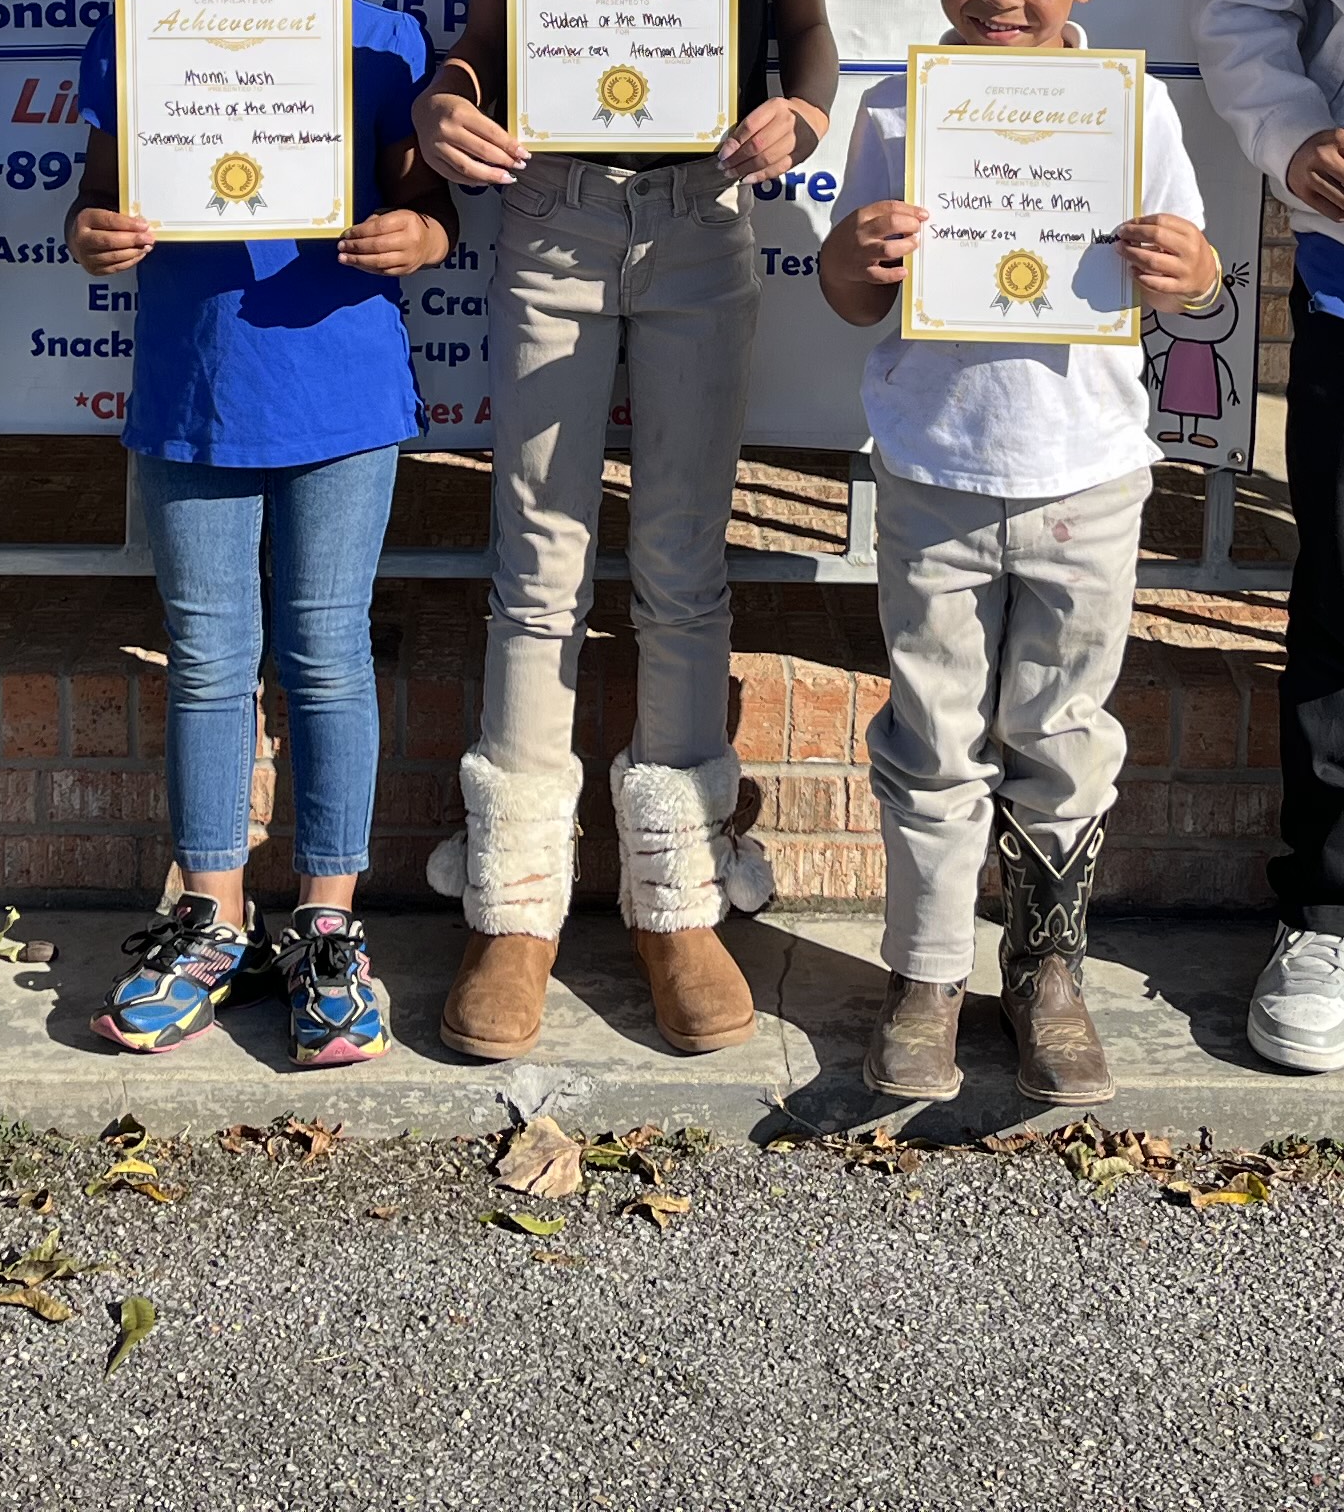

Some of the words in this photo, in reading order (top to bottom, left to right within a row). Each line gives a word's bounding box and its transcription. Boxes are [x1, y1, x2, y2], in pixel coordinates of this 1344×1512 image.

[152, 8, 316, 33] Achievement
[539, 11, 589, 29] Student
[614, 11, 636, 27] the
[236, 69, 275, 86] Wash
[984, 86, 1049, 96] CERTIFICATE
[1051, 88, 1065, 96] OF
[164, 100, 220, 117] Student
[244, 101, 267, 116] the
[942, 99, 1108, 126] Achievement
[1028, 164, 1073, 181] Weeks
[938, 191, 992, 209] Student
[1019, 192, 1044, 210] the
[991, 229, 1016, 241] 2024
